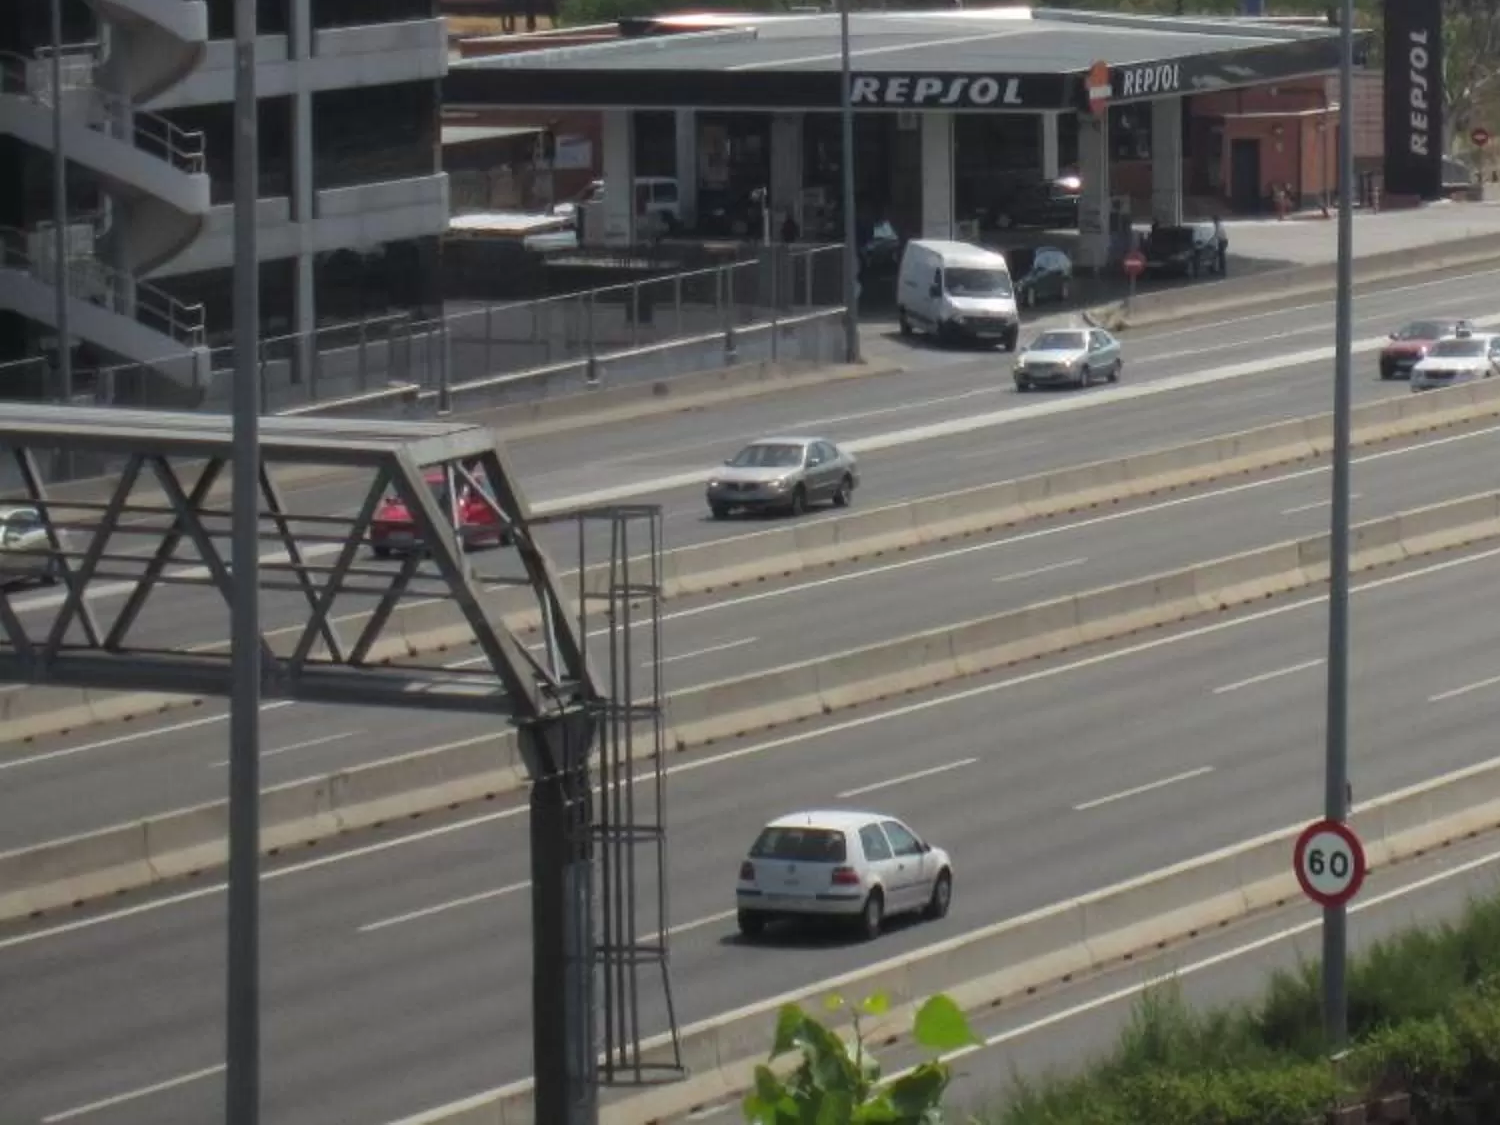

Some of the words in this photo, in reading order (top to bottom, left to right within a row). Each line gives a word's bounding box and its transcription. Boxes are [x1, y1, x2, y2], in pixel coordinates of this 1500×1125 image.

[851, 77, 1023, 104] REPSOL
[1122, 63, 1180, 96] REPSOL
[1409, 28, 1429, 156] REPSOL
[1309, 849, 1349, 879] 60
